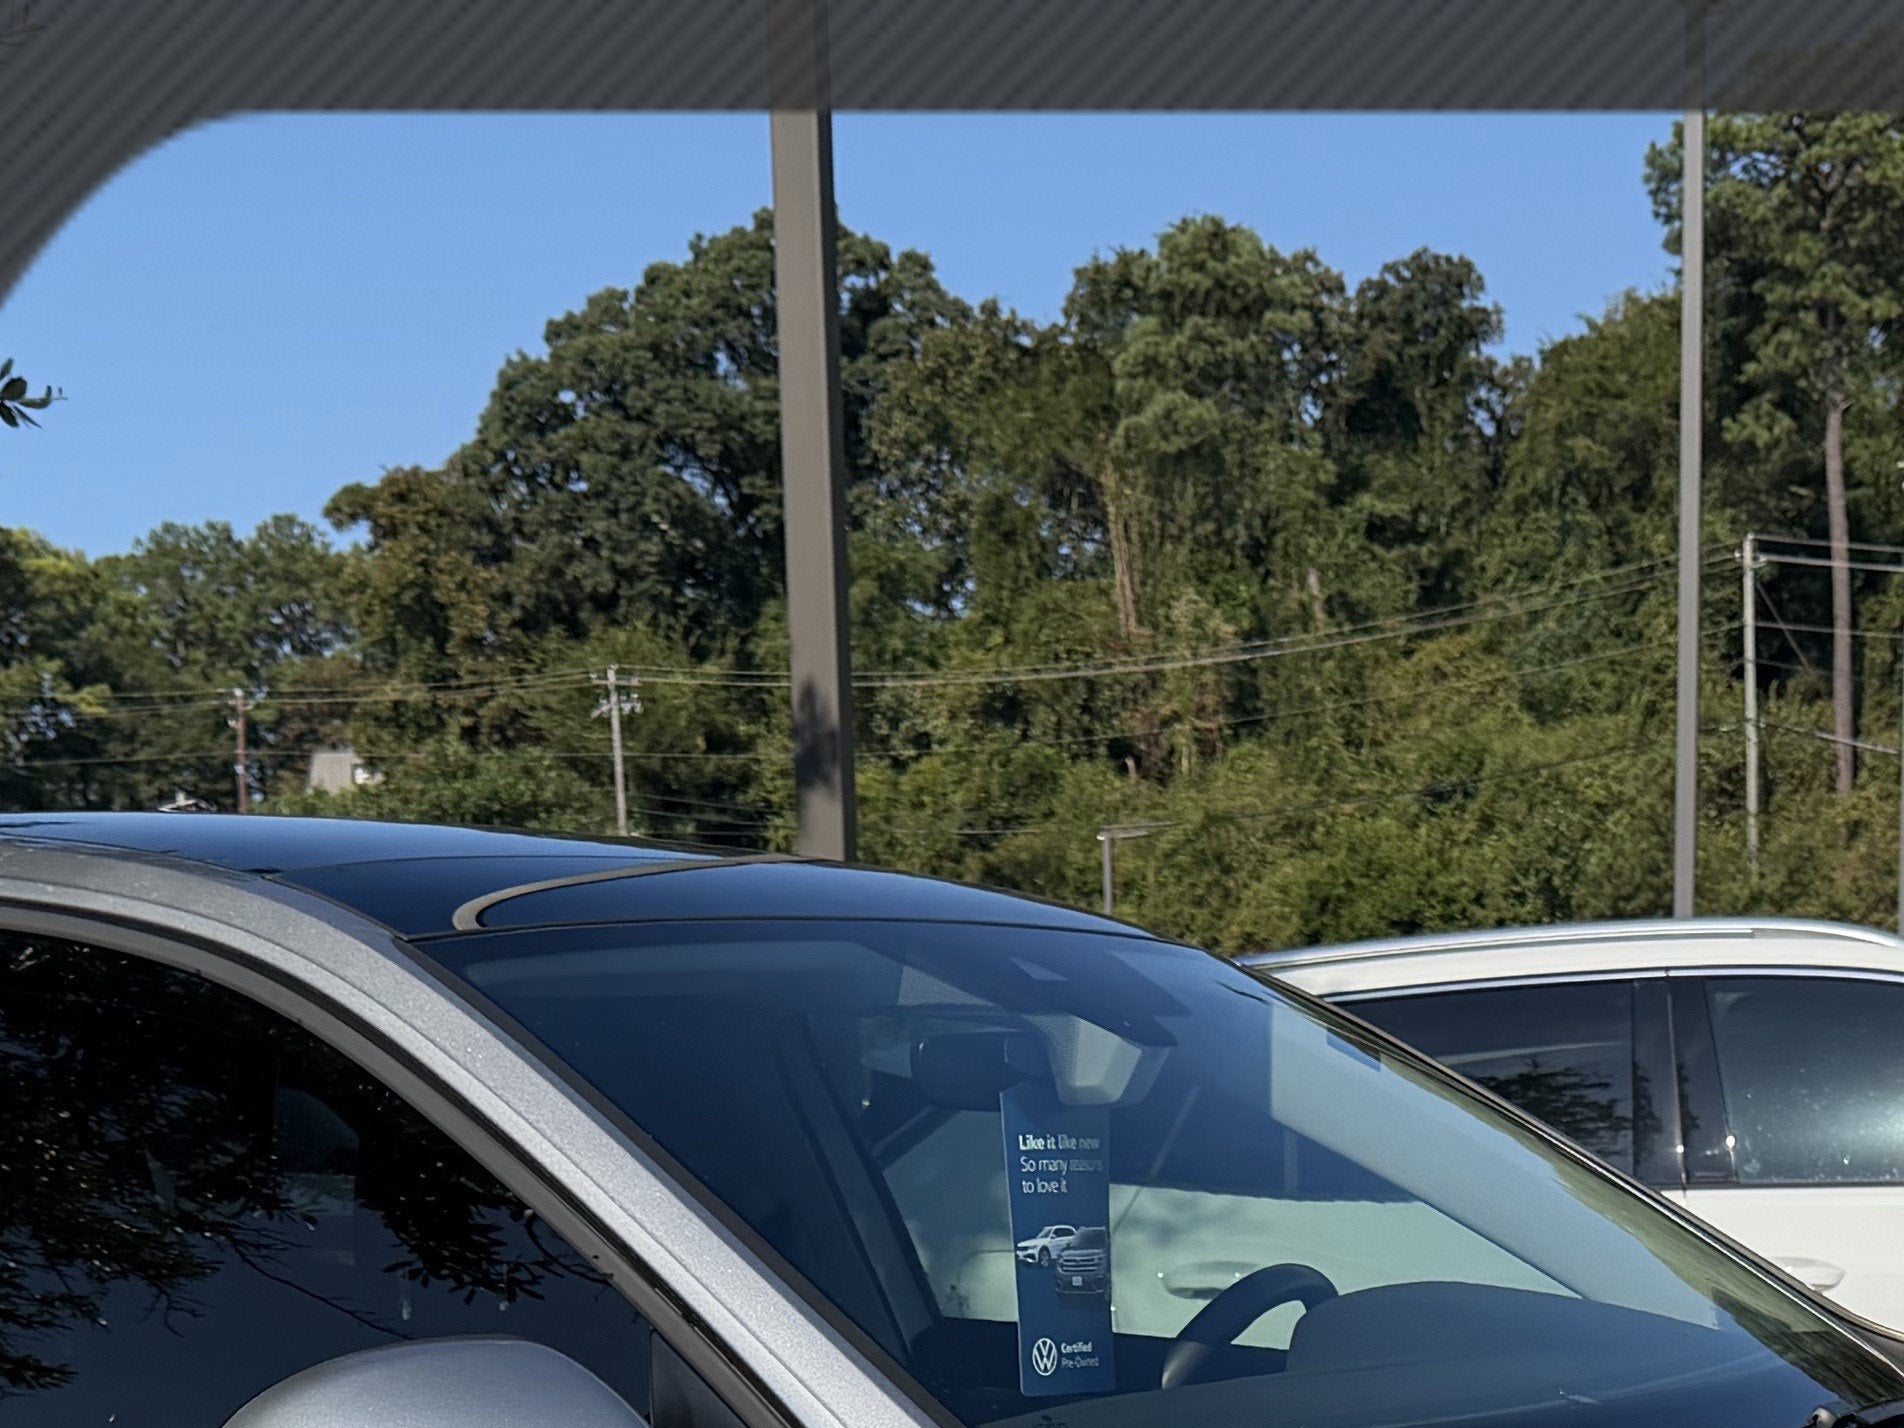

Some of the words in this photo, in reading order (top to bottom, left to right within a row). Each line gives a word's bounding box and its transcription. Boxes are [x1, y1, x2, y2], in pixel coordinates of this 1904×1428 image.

[1018, 1134, 1045, 1150] Like
[1046, 1133, 1056, 1150] it
[1020, 1155, 1036, 1172] So
[1038, 1159, 1068, 1176] many
[1022, 1180, 1035, 1194] to
